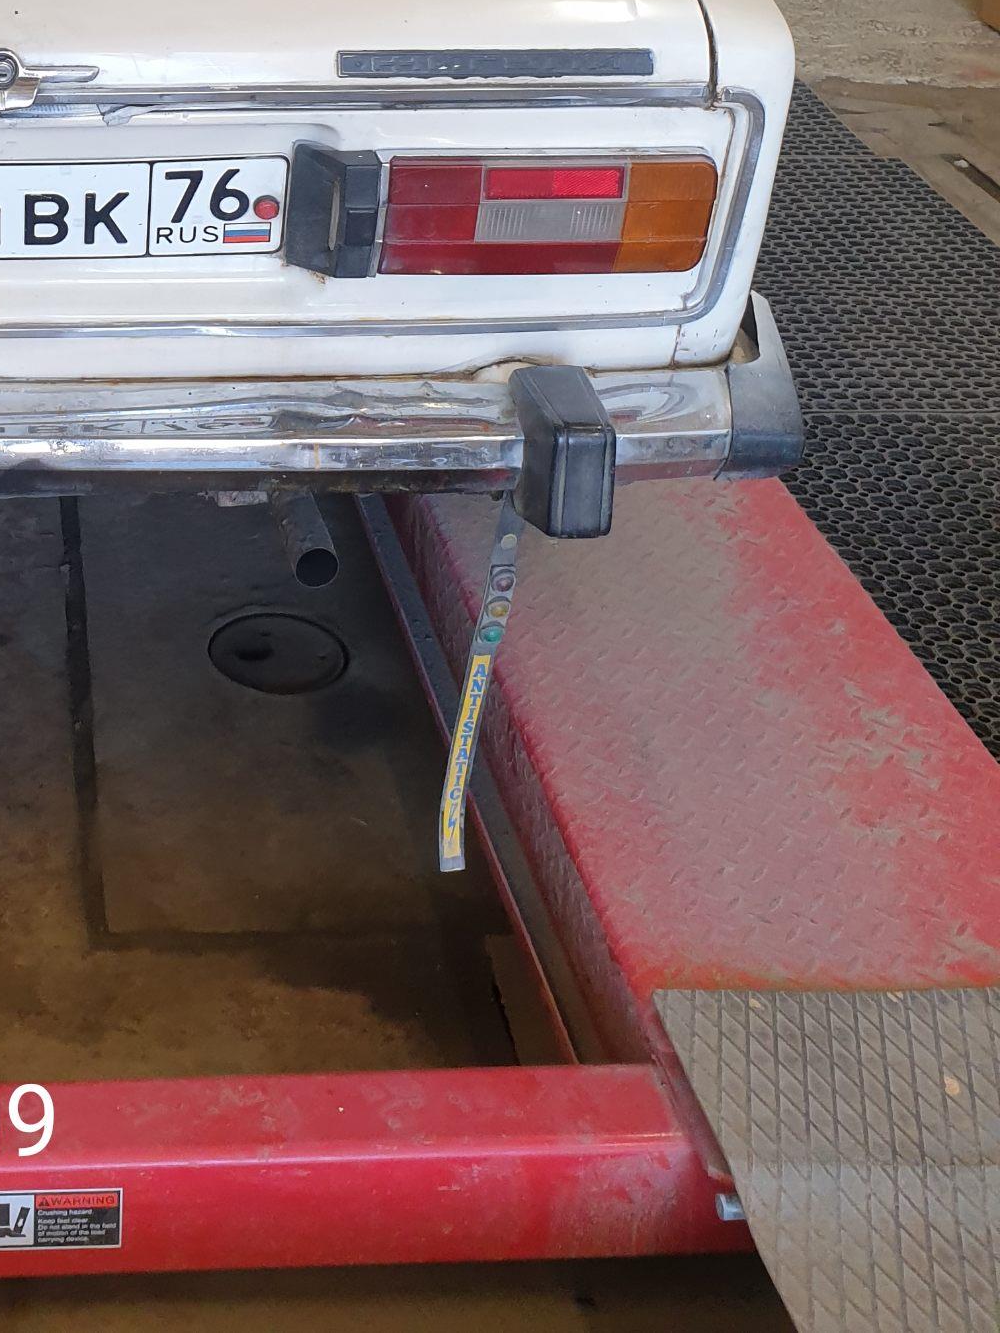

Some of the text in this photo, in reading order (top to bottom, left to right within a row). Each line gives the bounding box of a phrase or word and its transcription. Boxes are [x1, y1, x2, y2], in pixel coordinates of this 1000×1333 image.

[165, 168, 250, 224] 76
[156, 226, 219, 244] RUS
[448, 662, 489, 801] ANTISTATIC
[51, 1195, 115, 1206] WARNING
